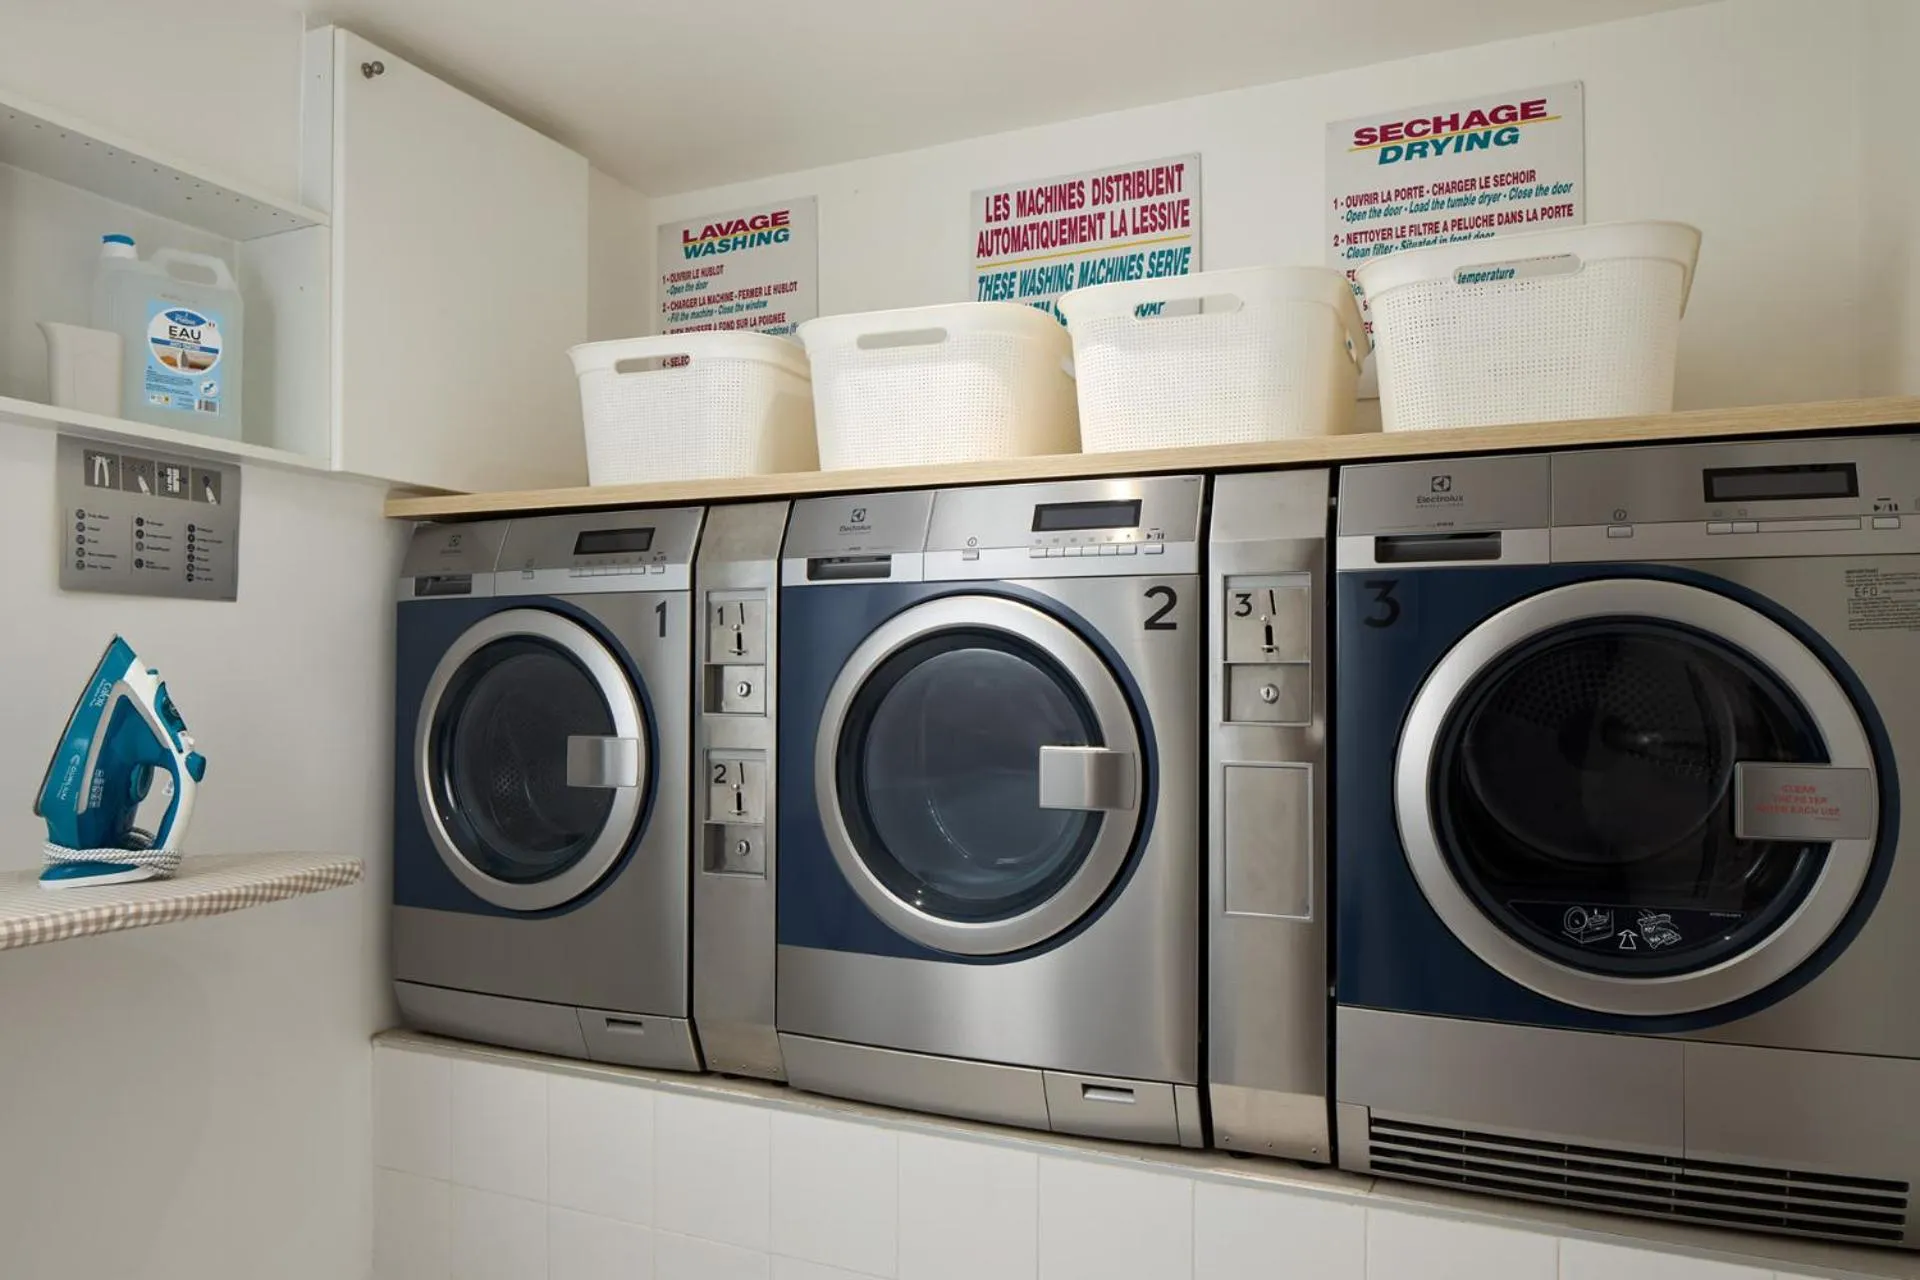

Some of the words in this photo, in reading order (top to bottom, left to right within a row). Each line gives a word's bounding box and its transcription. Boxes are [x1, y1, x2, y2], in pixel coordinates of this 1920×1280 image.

[1353, 99, 1547, 146] SECHAGE
[1378, 127, 1520, 165] DRYING
[985, 193, 1010, 223] LES
[1016, 180, 1085, 219] MACHINES
[1092, 163, 1184, 206] DISTRIBUENT
[1333, 198, 1338, 210] 1
[1345, 191, 1378, 208] OUVRIR
[1381, 189, 1392, 203] LA
[1394, 185, 1424, 202] PORTE
[1432, 177, 1477, 196] CHARGER
[1479, 175, 1491, 189] LE
[1493, 169, 1536, 187] SECHOIR
[1346, 209, 1367, 224] Open
[1369, 206, 1382, 219] the
[1384, 204, 1403, 217] door
[1409, 199, 1430, 214] Load
[1431, 198, 1445, 211] the
[1447, 193, 1477, 208] tumble
[1478, 191, 1502, 206] dryer
[1508, 187, 1533, 201] Close
[1535, 183, 1550, 197] the
[1551, 181, 1574, 195] door
[683, 210, 790, 243] LAVAGE
[976, 212, 1105, 258] AUTOMATIQUEMENT
[1110, 210, 1128, 239] LA
[1132, 198, 1190, 235] LESSIVE
[1333, 234, 1340, 247] 2
[1346, 227, 1393, 245] NETTOYER
[1395, 225, 1407, 239] LE
[1408, 220, 1440, 237] FILTRE
[1442, 220, 1449, 233] A
[1451, 214, 1495, 232] PELUCHE
[1497, 209, 1524, 226] DANS
[1526, 208, 1538, 222] LA
[1541, 203, 1574, 220] PORTE
[684, 228, 790, 260] WASHING
[1346, 245, 1370, 259] Clean
[1372, 243, 1393, 256] filter
[670, 271, 691, 283] OUVRIR
[692, 269, 699, 279] LE
[701, 264, 724, 277] HUBLOT
[670, 284, 684, 295] Open
[977, 271, 1017, 302] THESE
[1019, 262, 1074, 300] WASHING
[1077, 253, 1145, 288] MACHINES
[1147, 246, 1192, 279] SERVE
[1457, 267, 1515, 285] temperature
[670, 298, 697, 311] CHARGER
[699, 296, 707, 308] LA
[707, 291, 734, 305] MACHINE
[738, 286, 763, 299] FERMER
[764, 285, 772, 296] LE
[773, 281, 797, 294] HUBLOT
[169, 325, 201, 340] EAU
[750, 316, 756, 327] LA
[759, 312, 786, 325] POIGNEE
[656, 601, 666, 637] 1
[717, 606, 724, 626] 1
[1143, 585, 1178, 631] 2
[1234, 593, 1252, 617] 3
[1363, 579, 1400, 629] 3
[714, 764, 727, 784] 2
